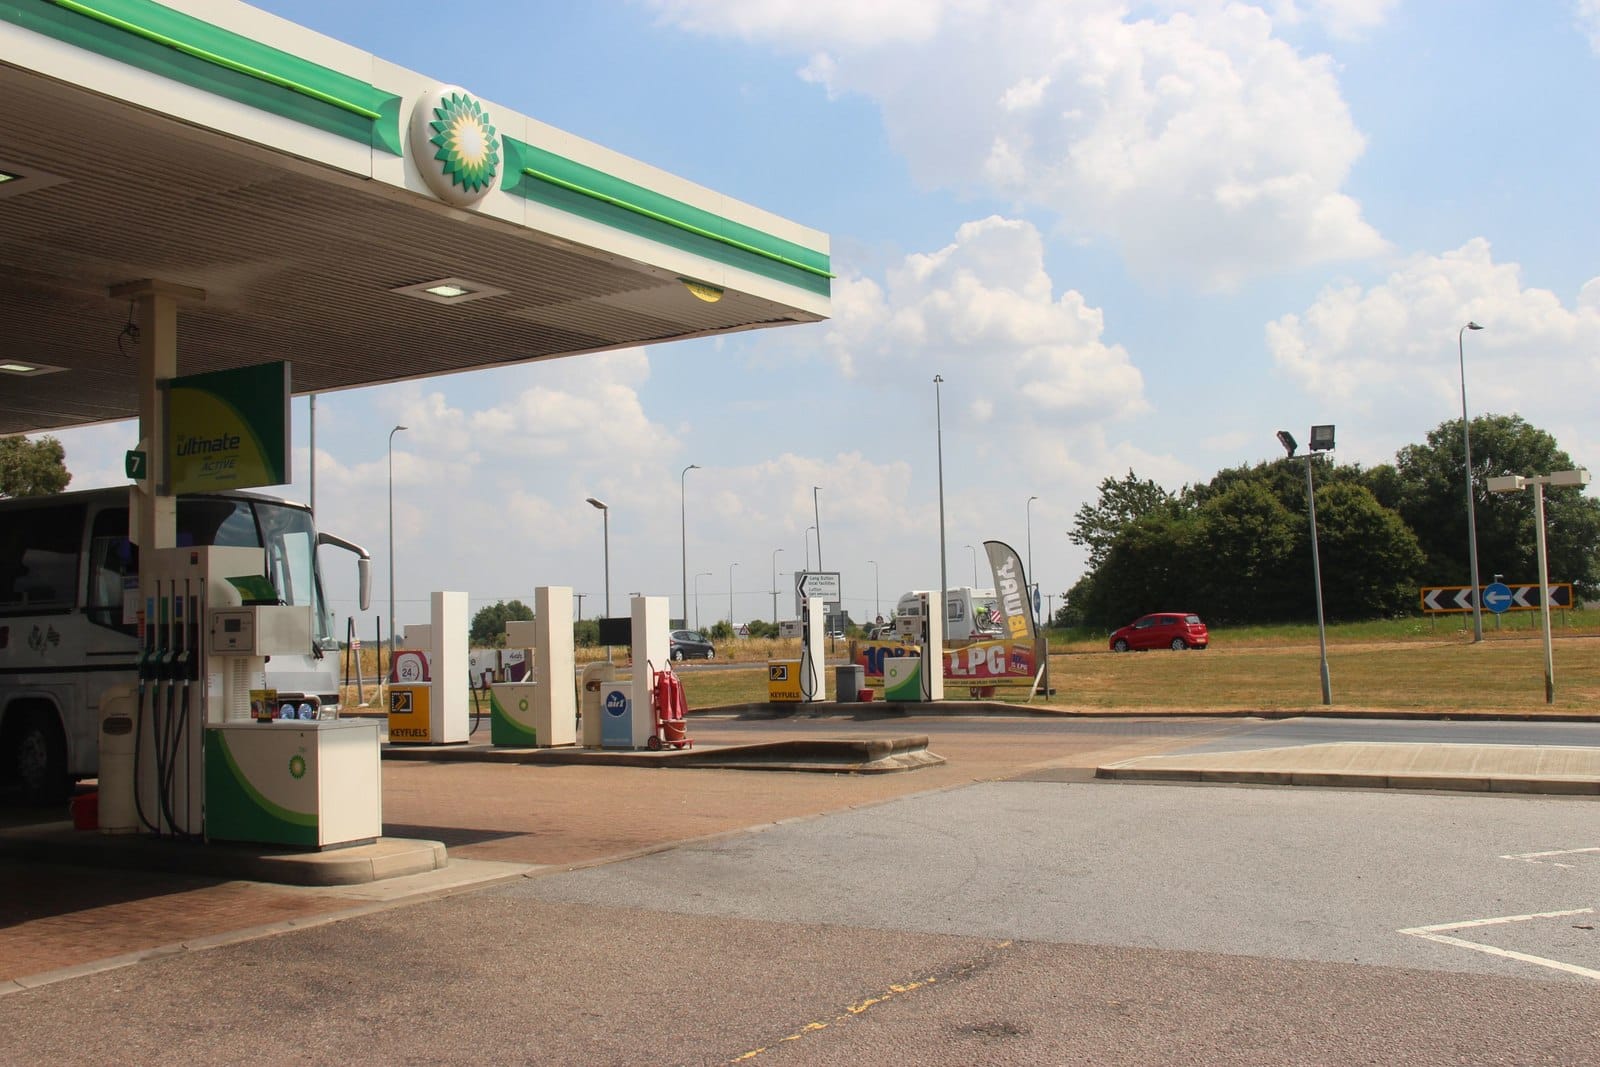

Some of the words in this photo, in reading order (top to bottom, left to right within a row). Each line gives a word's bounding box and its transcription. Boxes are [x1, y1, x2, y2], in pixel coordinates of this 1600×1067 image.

[176, 432, 241, 457] ultimate
[131, 457, 140, 473] 7
[202, 459, 237, 473] ACTIVE
[950, 645, 1006, 675] LPG
[402, 668, 412, 677] 24
[390, 728, 428, 737] KEYFUELS
